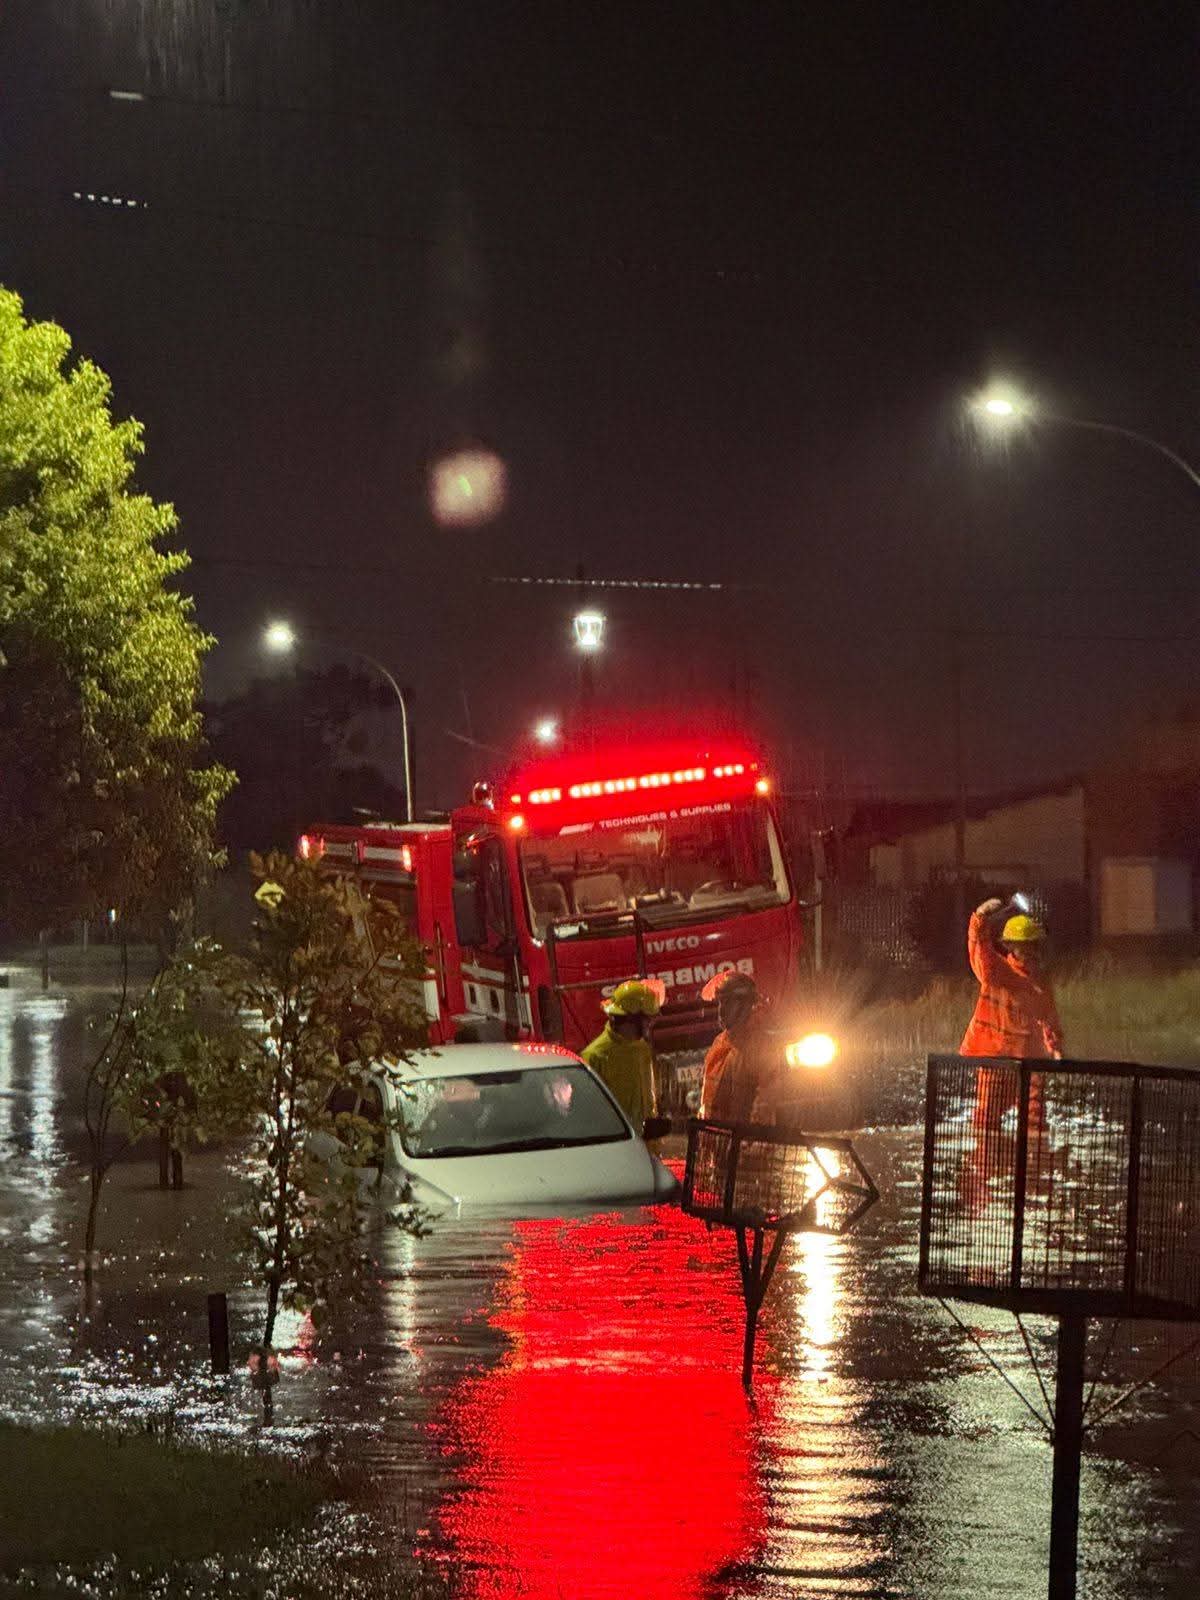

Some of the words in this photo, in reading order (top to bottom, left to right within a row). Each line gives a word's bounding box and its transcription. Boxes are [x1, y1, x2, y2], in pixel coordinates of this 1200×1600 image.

[599, 811, 668, 829] TECHNIQUES
[670, 809, 679, 819] &
[680, 802, 731, 817] SUPPLIES
[646, 935, 700, 955] IVECO
